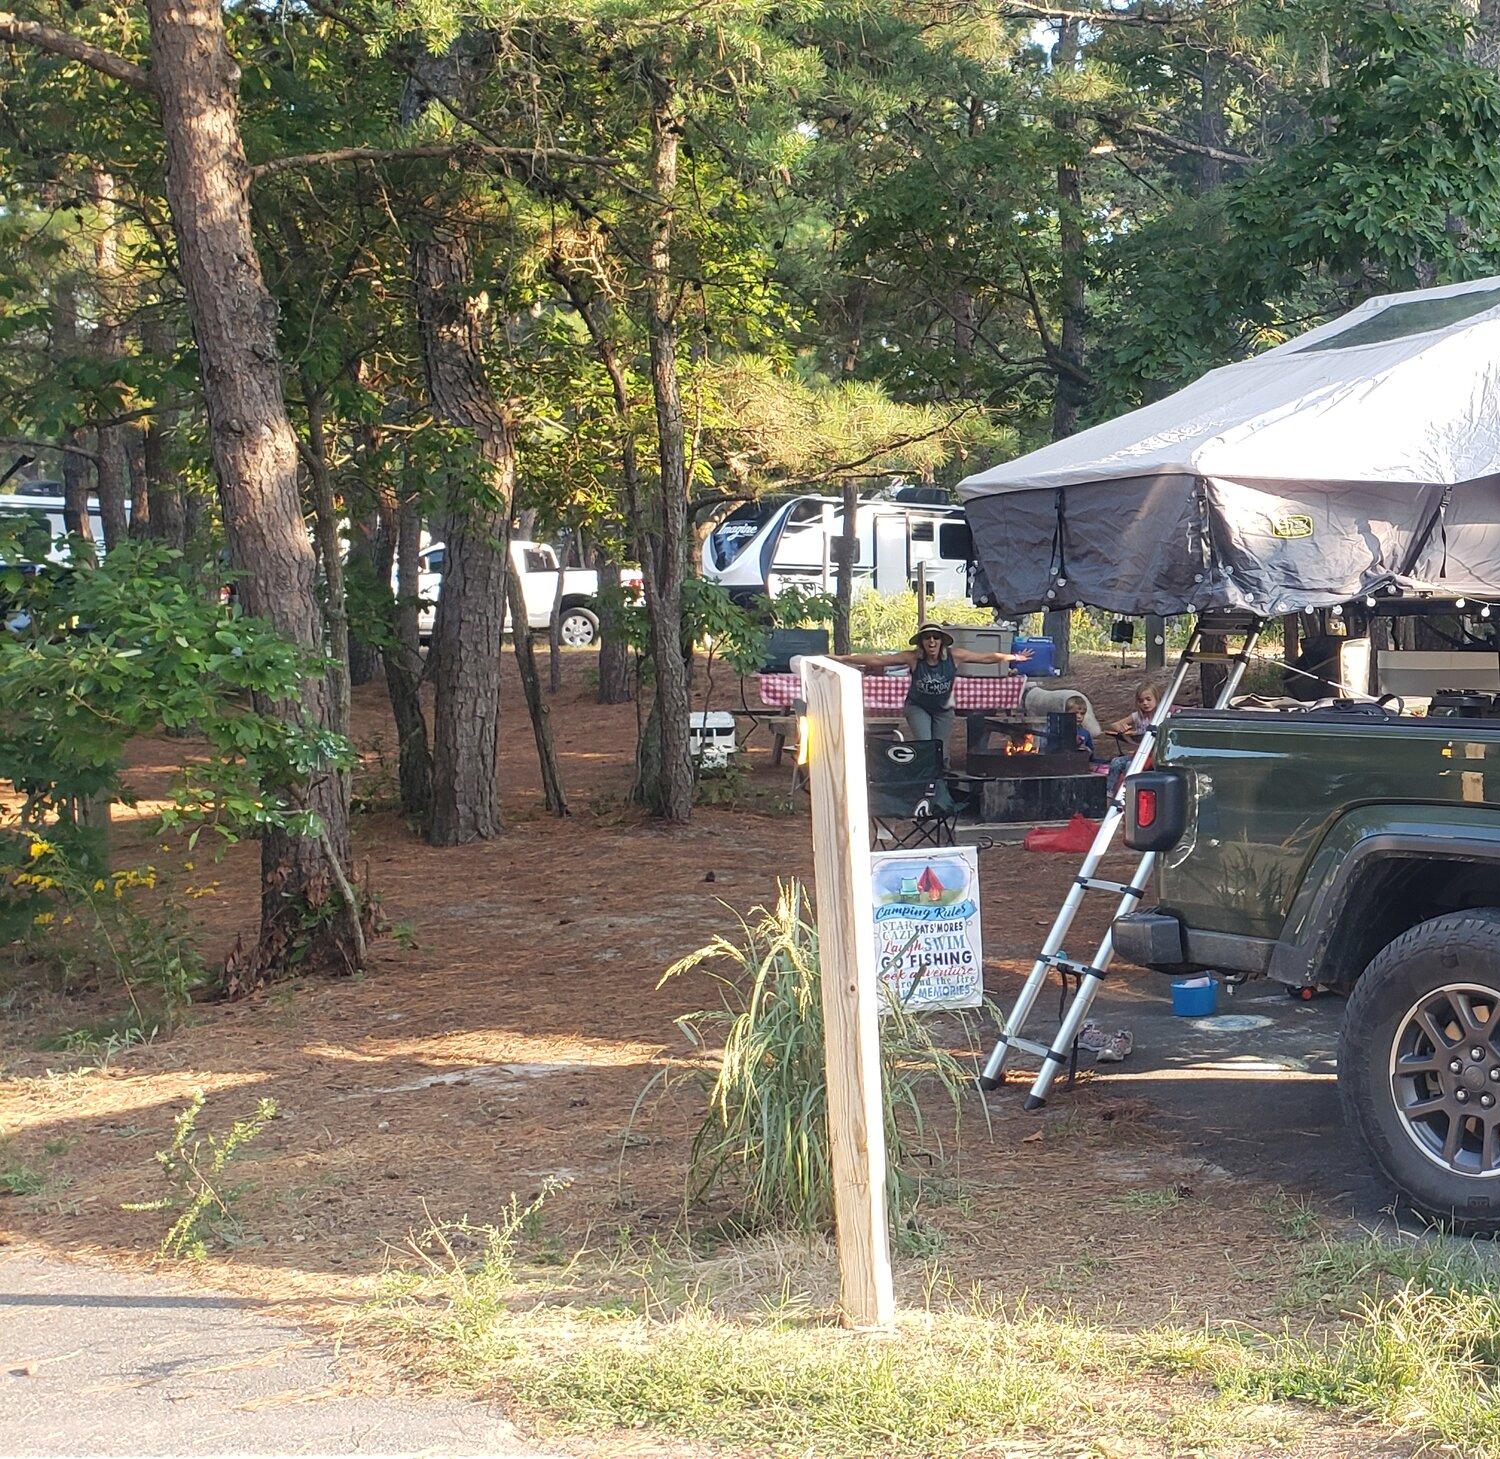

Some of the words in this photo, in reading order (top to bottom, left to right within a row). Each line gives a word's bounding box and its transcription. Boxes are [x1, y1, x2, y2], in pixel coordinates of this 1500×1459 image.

[717, 522, 758, 541] Imagine
[876, 906, 931, 920] Camping
[934, 904, 966, 919] Rules
[882, 921, 913, 930] STAR
[924, 934, 966, 951] SWIM
[881, 956, 904, 970] GO
[910, 950, 972, 968] FISHING
[883, 969, 906, 981] eek
[910, 965, 974, 979] aventure
[918, 984, 971, 998] MEMORIES
